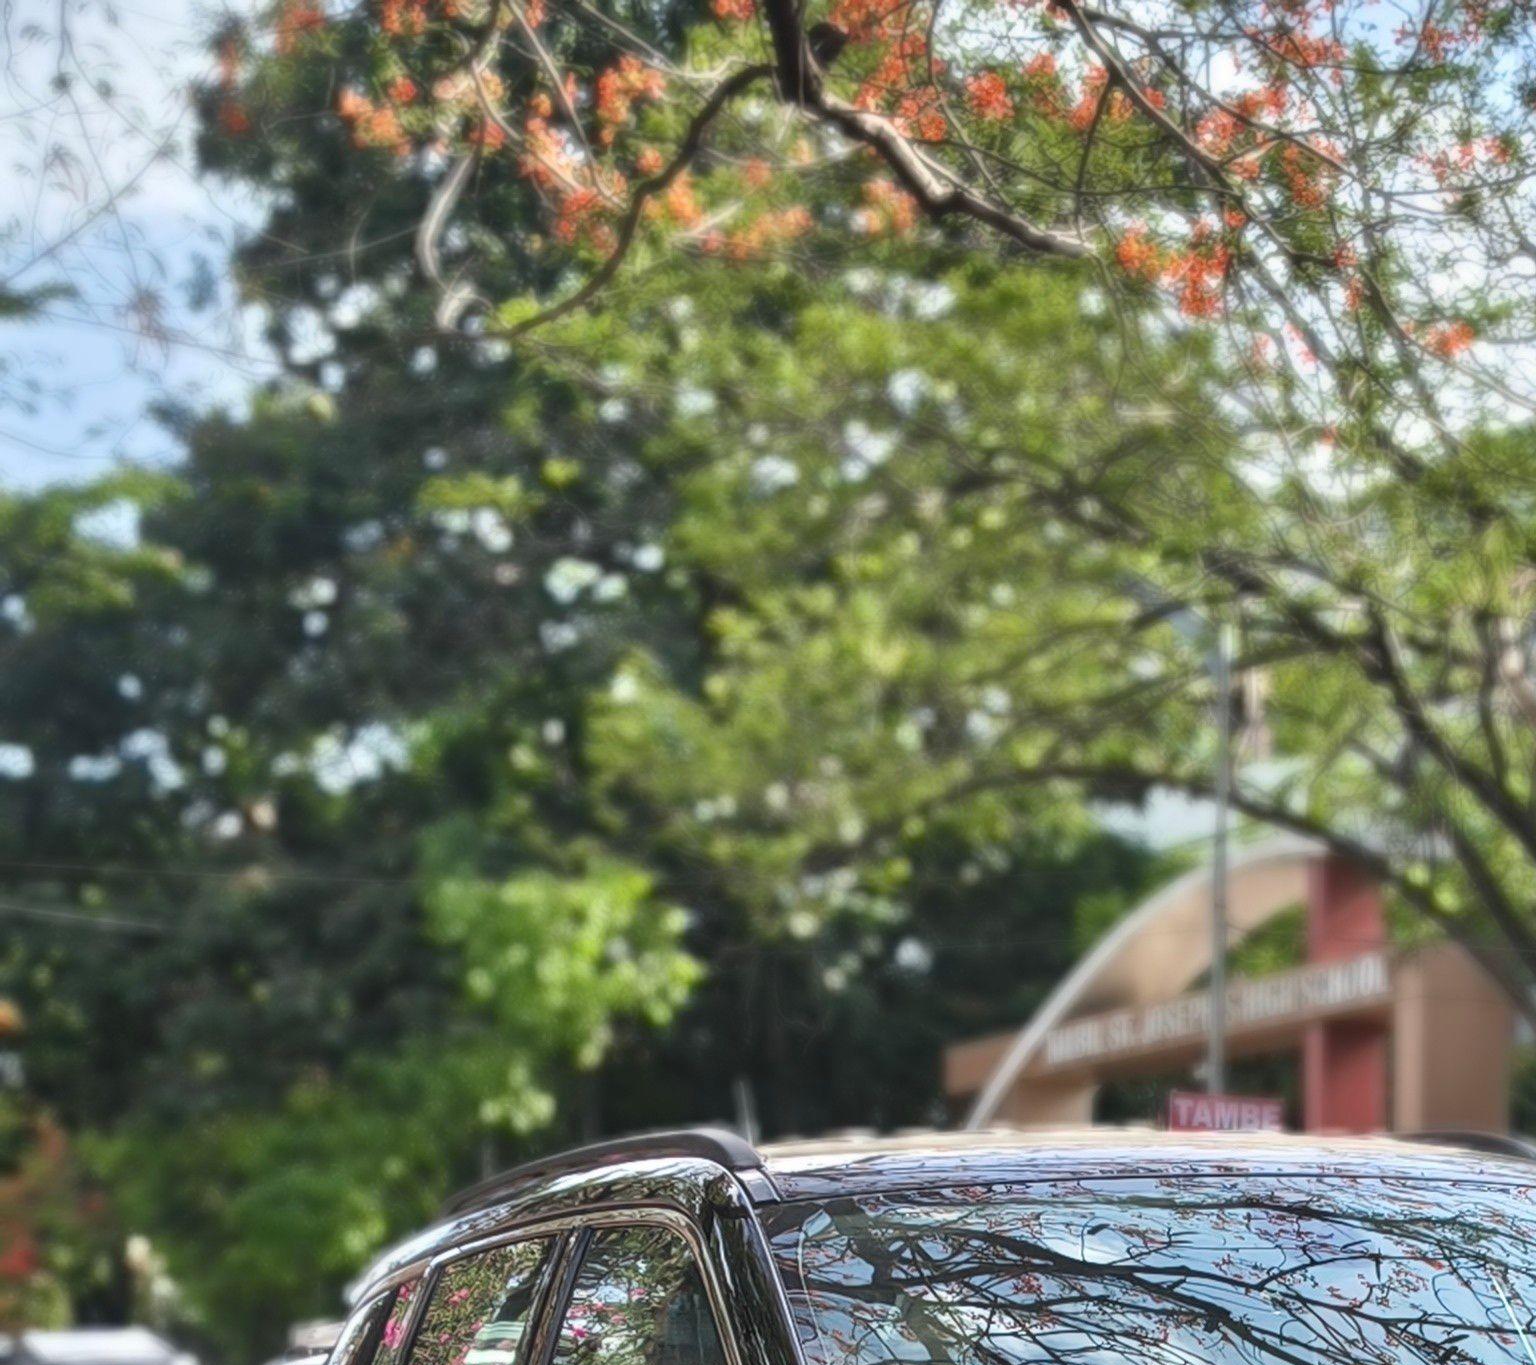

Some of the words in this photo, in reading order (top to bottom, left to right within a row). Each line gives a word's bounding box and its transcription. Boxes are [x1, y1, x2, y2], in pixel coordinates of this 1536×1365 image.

[1144, 981, 1243, 1044] JOSEPHS
[1298, 955, 1391, 1007] SCHOOL
[1173, 1097, 1281, 1131] TAMBE
